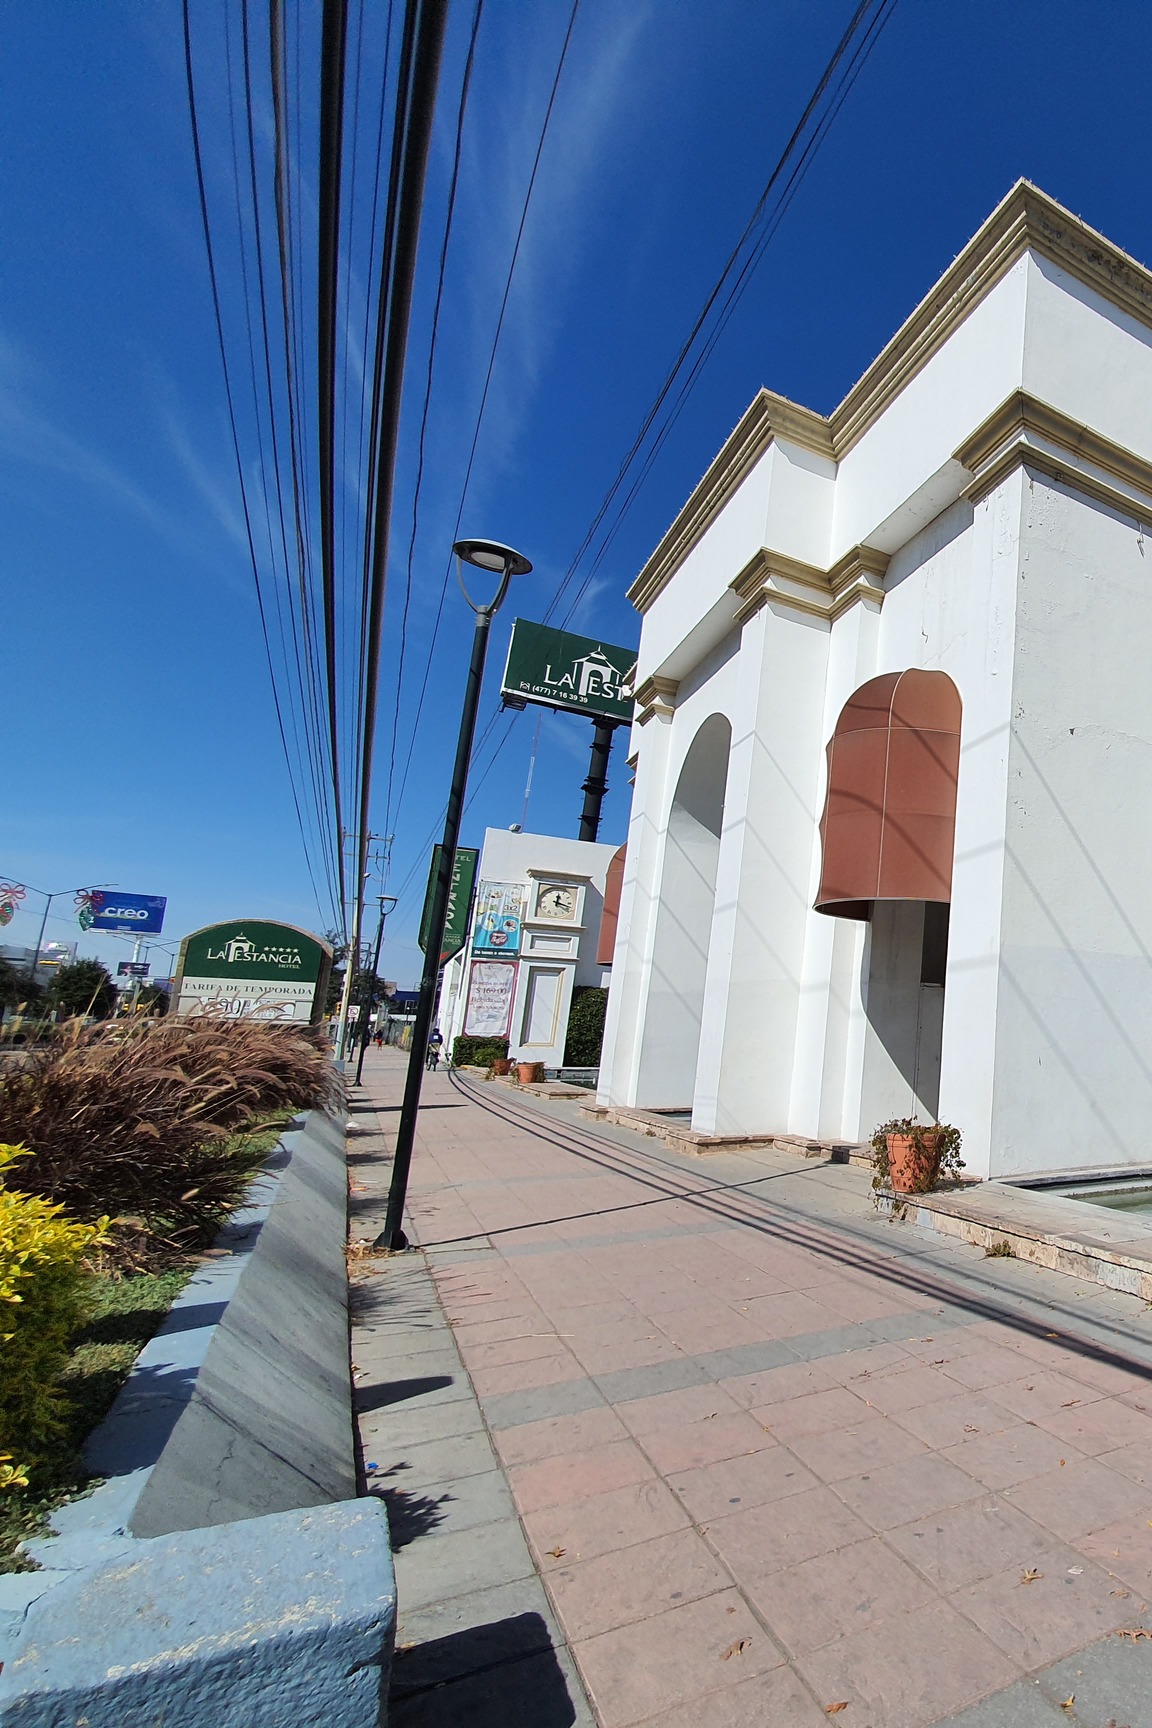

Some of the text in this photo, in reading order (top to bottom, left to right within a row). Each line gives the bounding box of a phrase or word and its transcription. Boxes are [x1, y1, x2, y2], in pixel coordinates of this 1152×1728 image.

[543, 664, 574, 689] LA
[532, 685, 551, 695] (477)
[559, 691, 567, 699] 16
[104, 906, 149, 919] creo
[207, 948, 302, 965] LA ESTANCIA
[184, 982, 312, 995] TARIFA DE TEMPORADA
